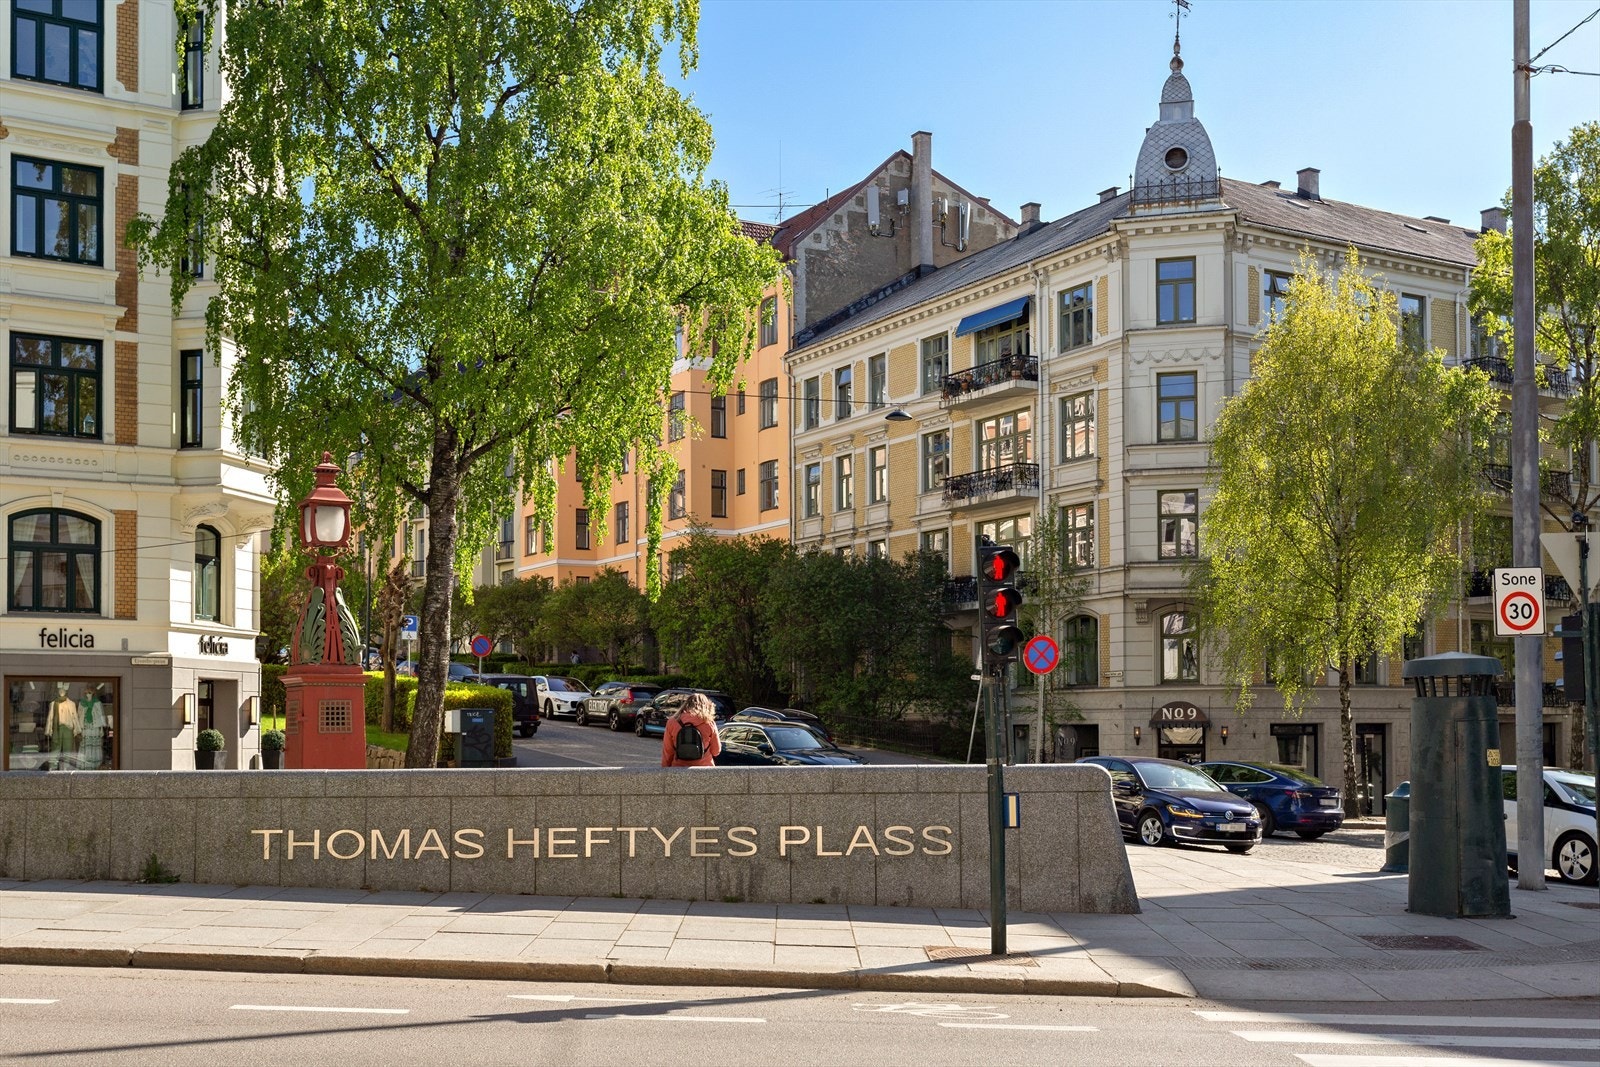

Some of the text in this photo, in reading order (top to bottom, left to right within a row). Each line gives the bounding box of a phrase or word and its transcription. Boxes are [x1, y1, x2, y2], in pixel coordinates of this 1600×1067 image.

[1501, 572, 1536, 586] Sone
[1509, 603, 1533, 620] 30
[38, 627, 95, 648] felicia
[198, 634, 229, 656] felicia
[250, 825, 953, 860] THOMAS HEFTYES PLASS
